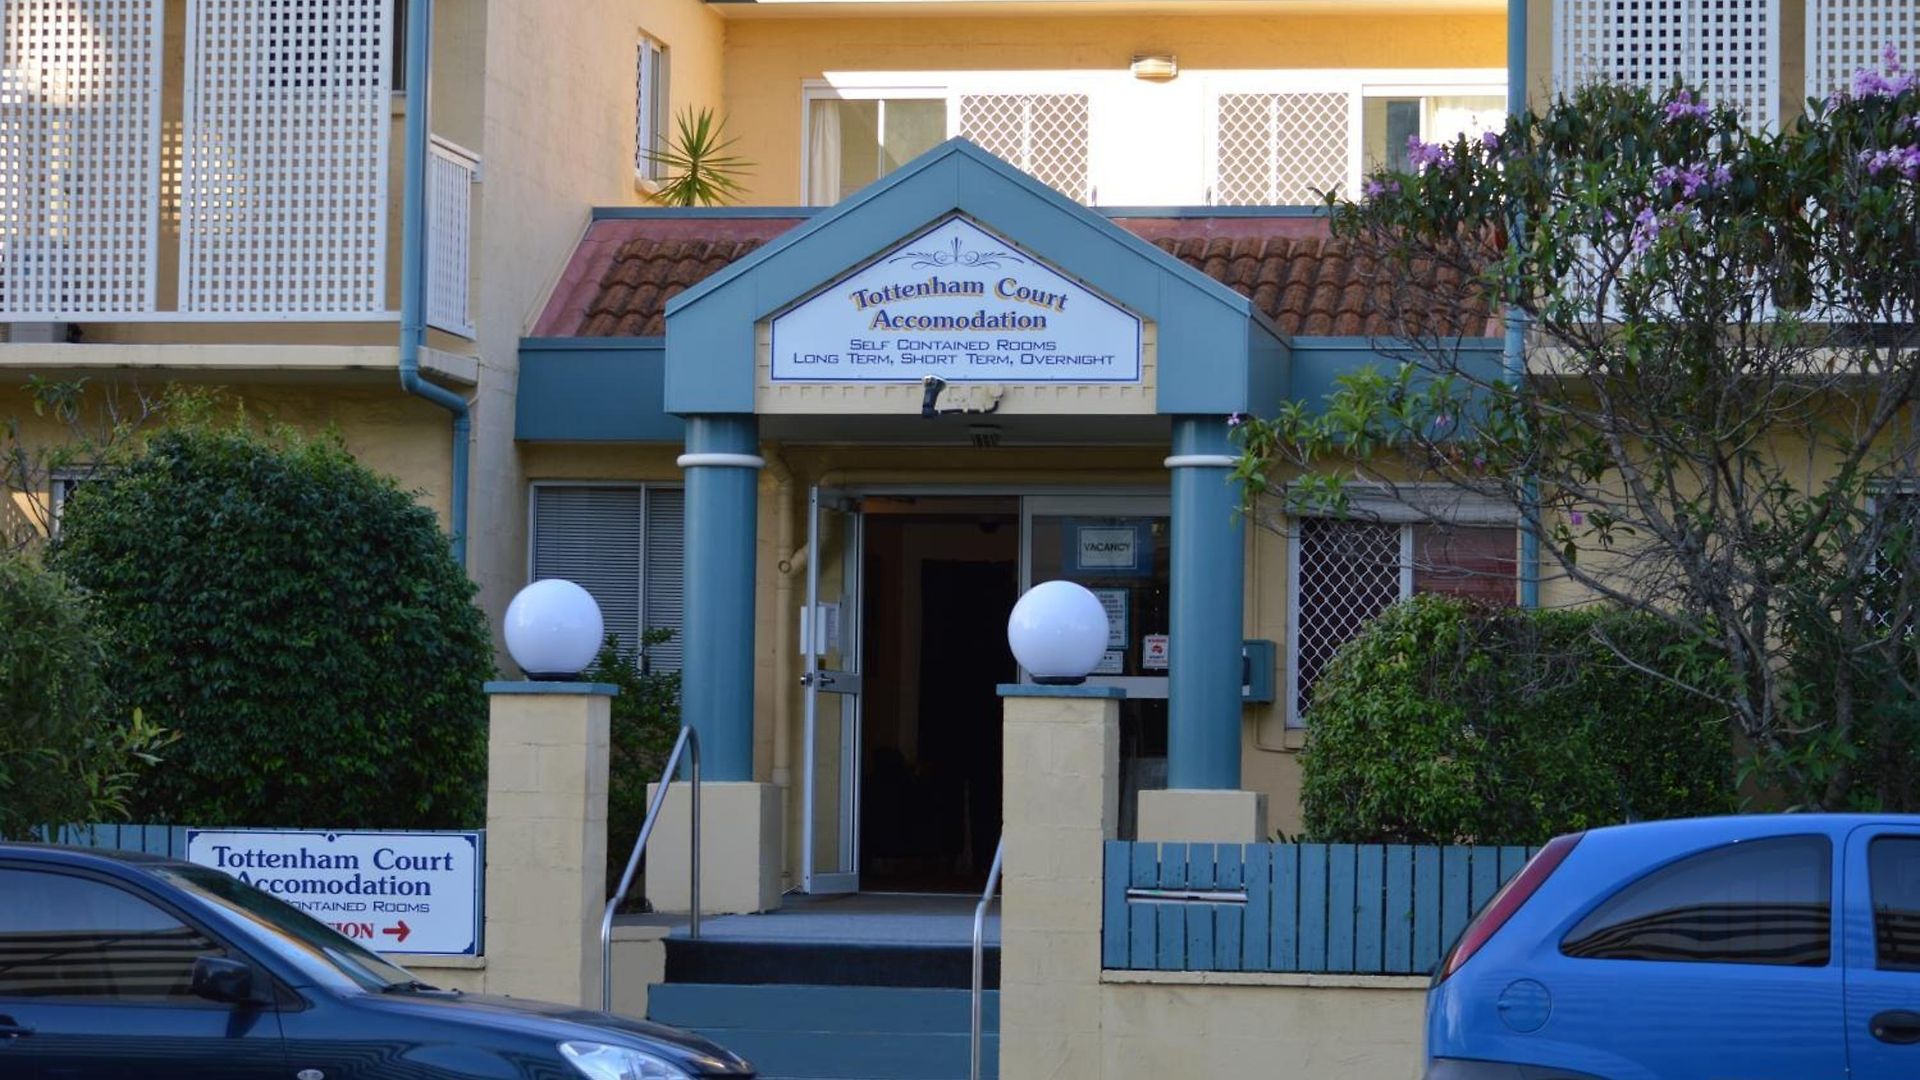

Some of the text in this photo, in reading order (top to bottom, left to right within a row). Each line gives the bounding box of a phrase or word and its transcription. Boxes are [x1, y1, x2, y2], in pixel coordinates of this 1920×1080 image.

[850, 276, 1069, 313] Tottenham Court
[870, 309, 1047, 331] Accomodation
[850, 339, 1058, 351] SELF CONTAINED ROOMS
[793, 352, 1116, 366] LONG TERM, SHORT TERM, OVERNIGHT
[1084, 543, 1130, 552] VACANCY
[212, 845, 454, 872] Tottenham Court
[373, 901, 430, 913] ROOMS
